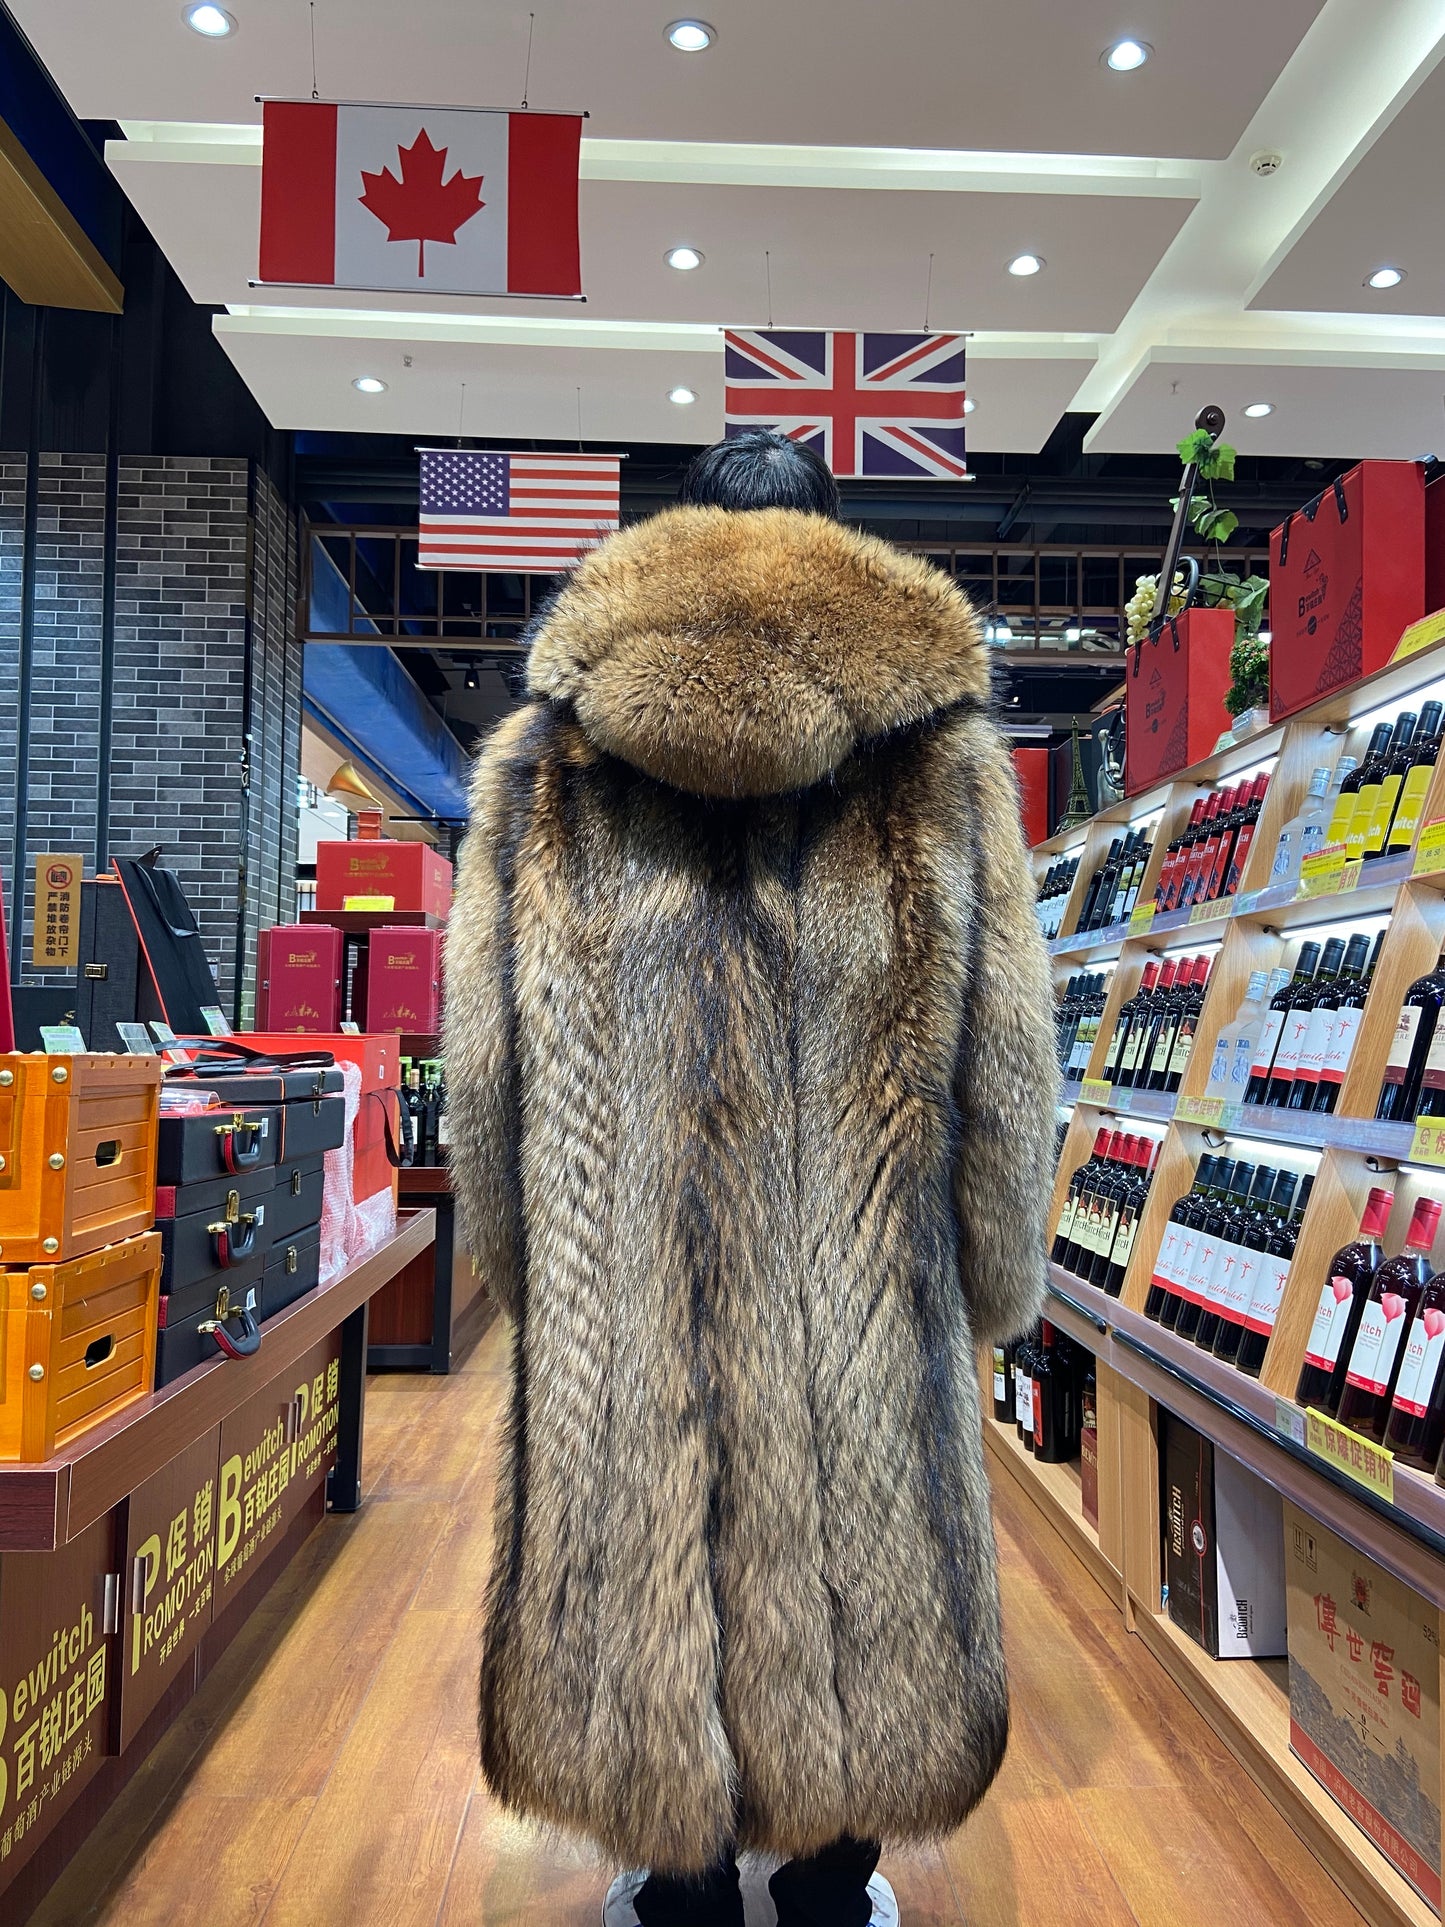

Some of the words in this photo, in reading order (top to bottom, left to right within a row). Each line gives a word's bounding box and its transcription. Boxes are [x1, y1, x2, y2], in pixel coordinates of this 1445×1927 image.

[45, 892, 58, 957] 严禁堆放杂物
[58, 892, 70, 957] 消防卷帘门下
[312, 1357, 339, 1421] 促销
[243, 1446, 290, 1534] 百锐庄园
[166, 1479, 213, 1583] 促销
[1236, 1599, 1248, 1639] BEWITCH
[14, 1643, 107, 1801] 百锐庄园
